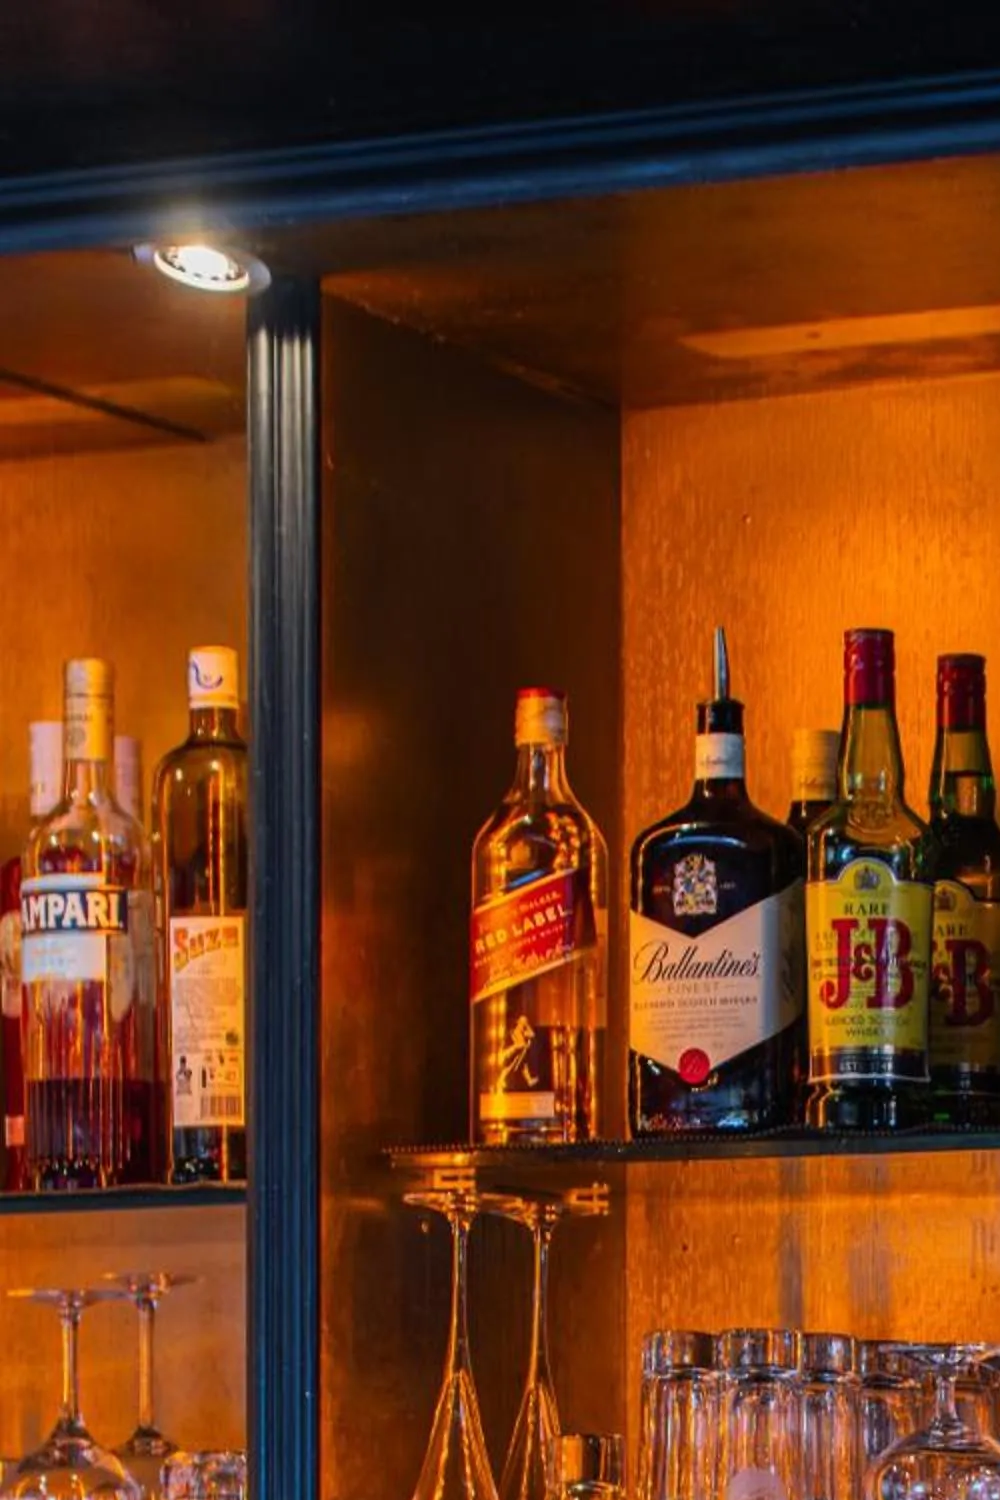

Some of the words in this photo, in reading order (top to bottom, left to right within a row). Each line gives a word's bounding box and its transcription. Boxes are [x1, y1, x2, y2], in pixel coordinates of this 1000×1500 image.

[20, 891, 118, 931] AMPARI
[474, 928, 508, 955] RED
[511, 902, 573, 938] LABEL
[843, 902, 890, 917] RARE
[934, 922, 970, 937] ARE
[633, 939, 762, 985] Ballantine's
[819, 917, 915, 1010] J&B
